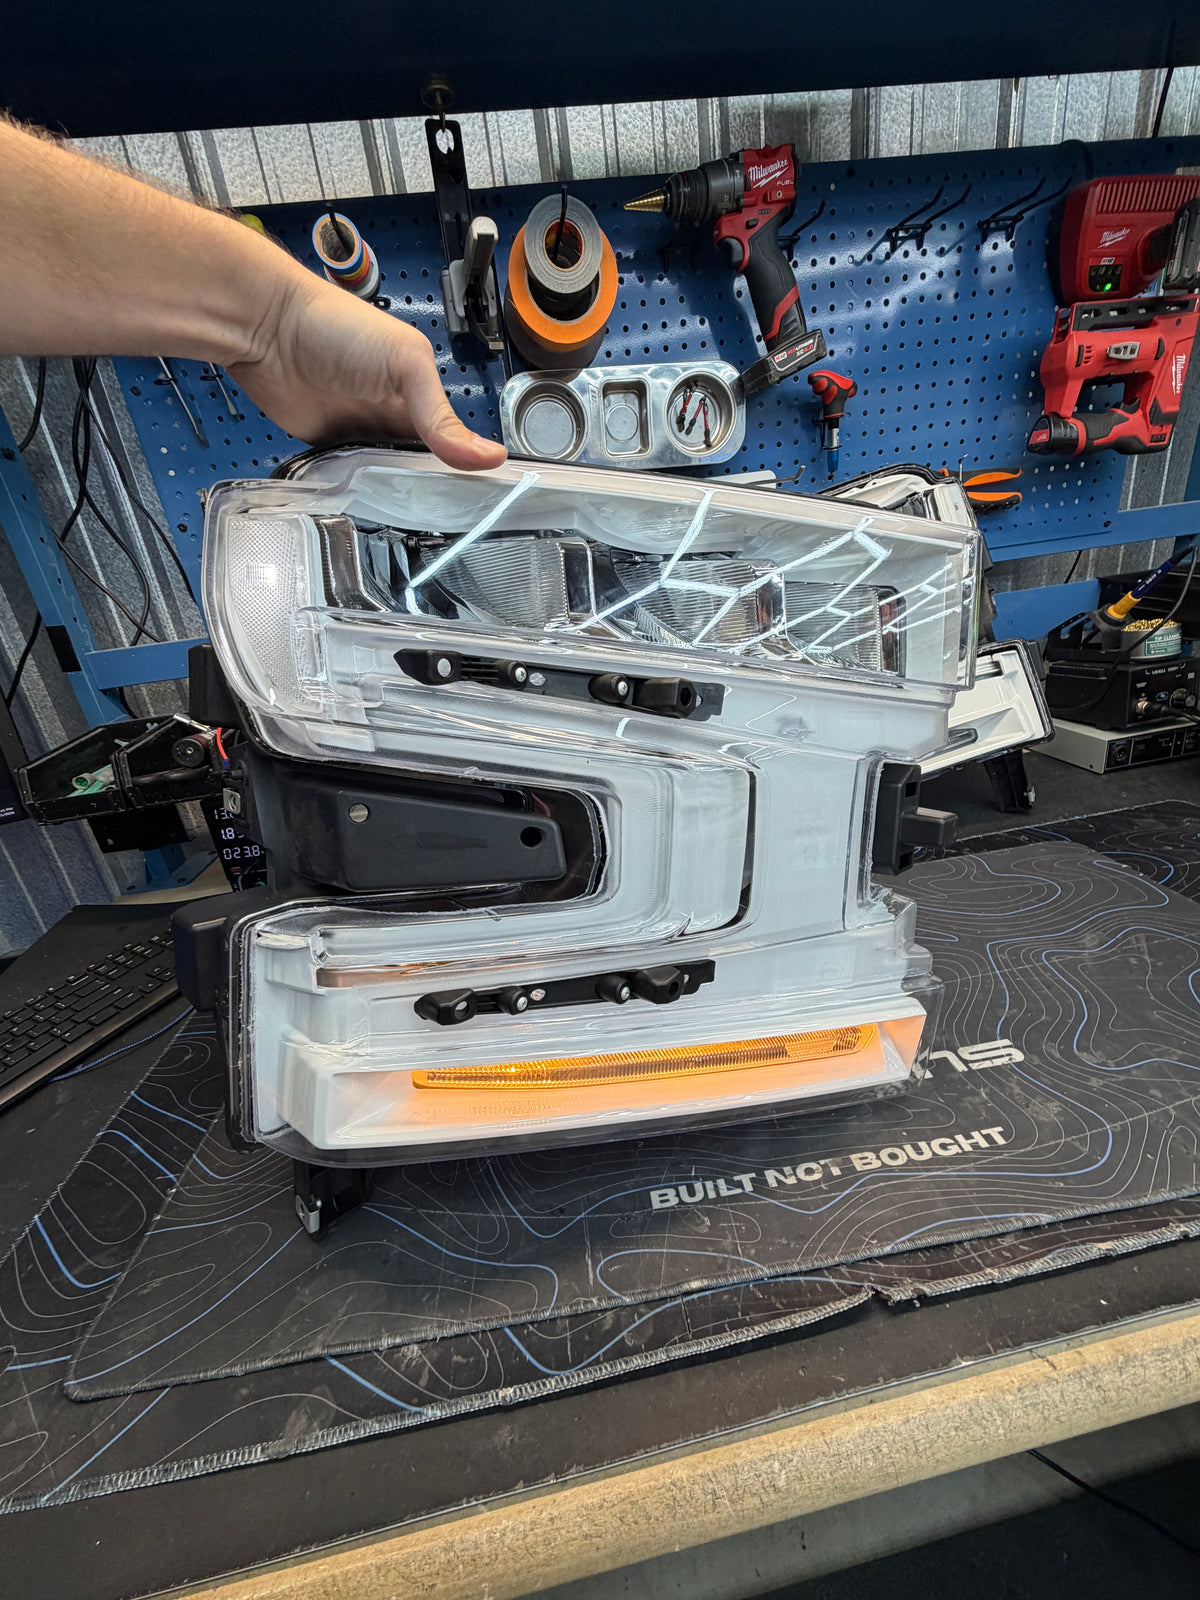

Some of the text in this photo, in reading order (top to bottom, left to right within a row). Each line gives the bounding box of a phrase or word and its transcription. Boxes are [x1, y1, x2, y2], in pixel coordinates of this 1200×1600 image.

[748, 159, 788, 182] Milwaukee
[1176, 353, 1186, 394] Milwaukee
[650, 1126, 1007, 1210] BUILT NOT BOUGHT
